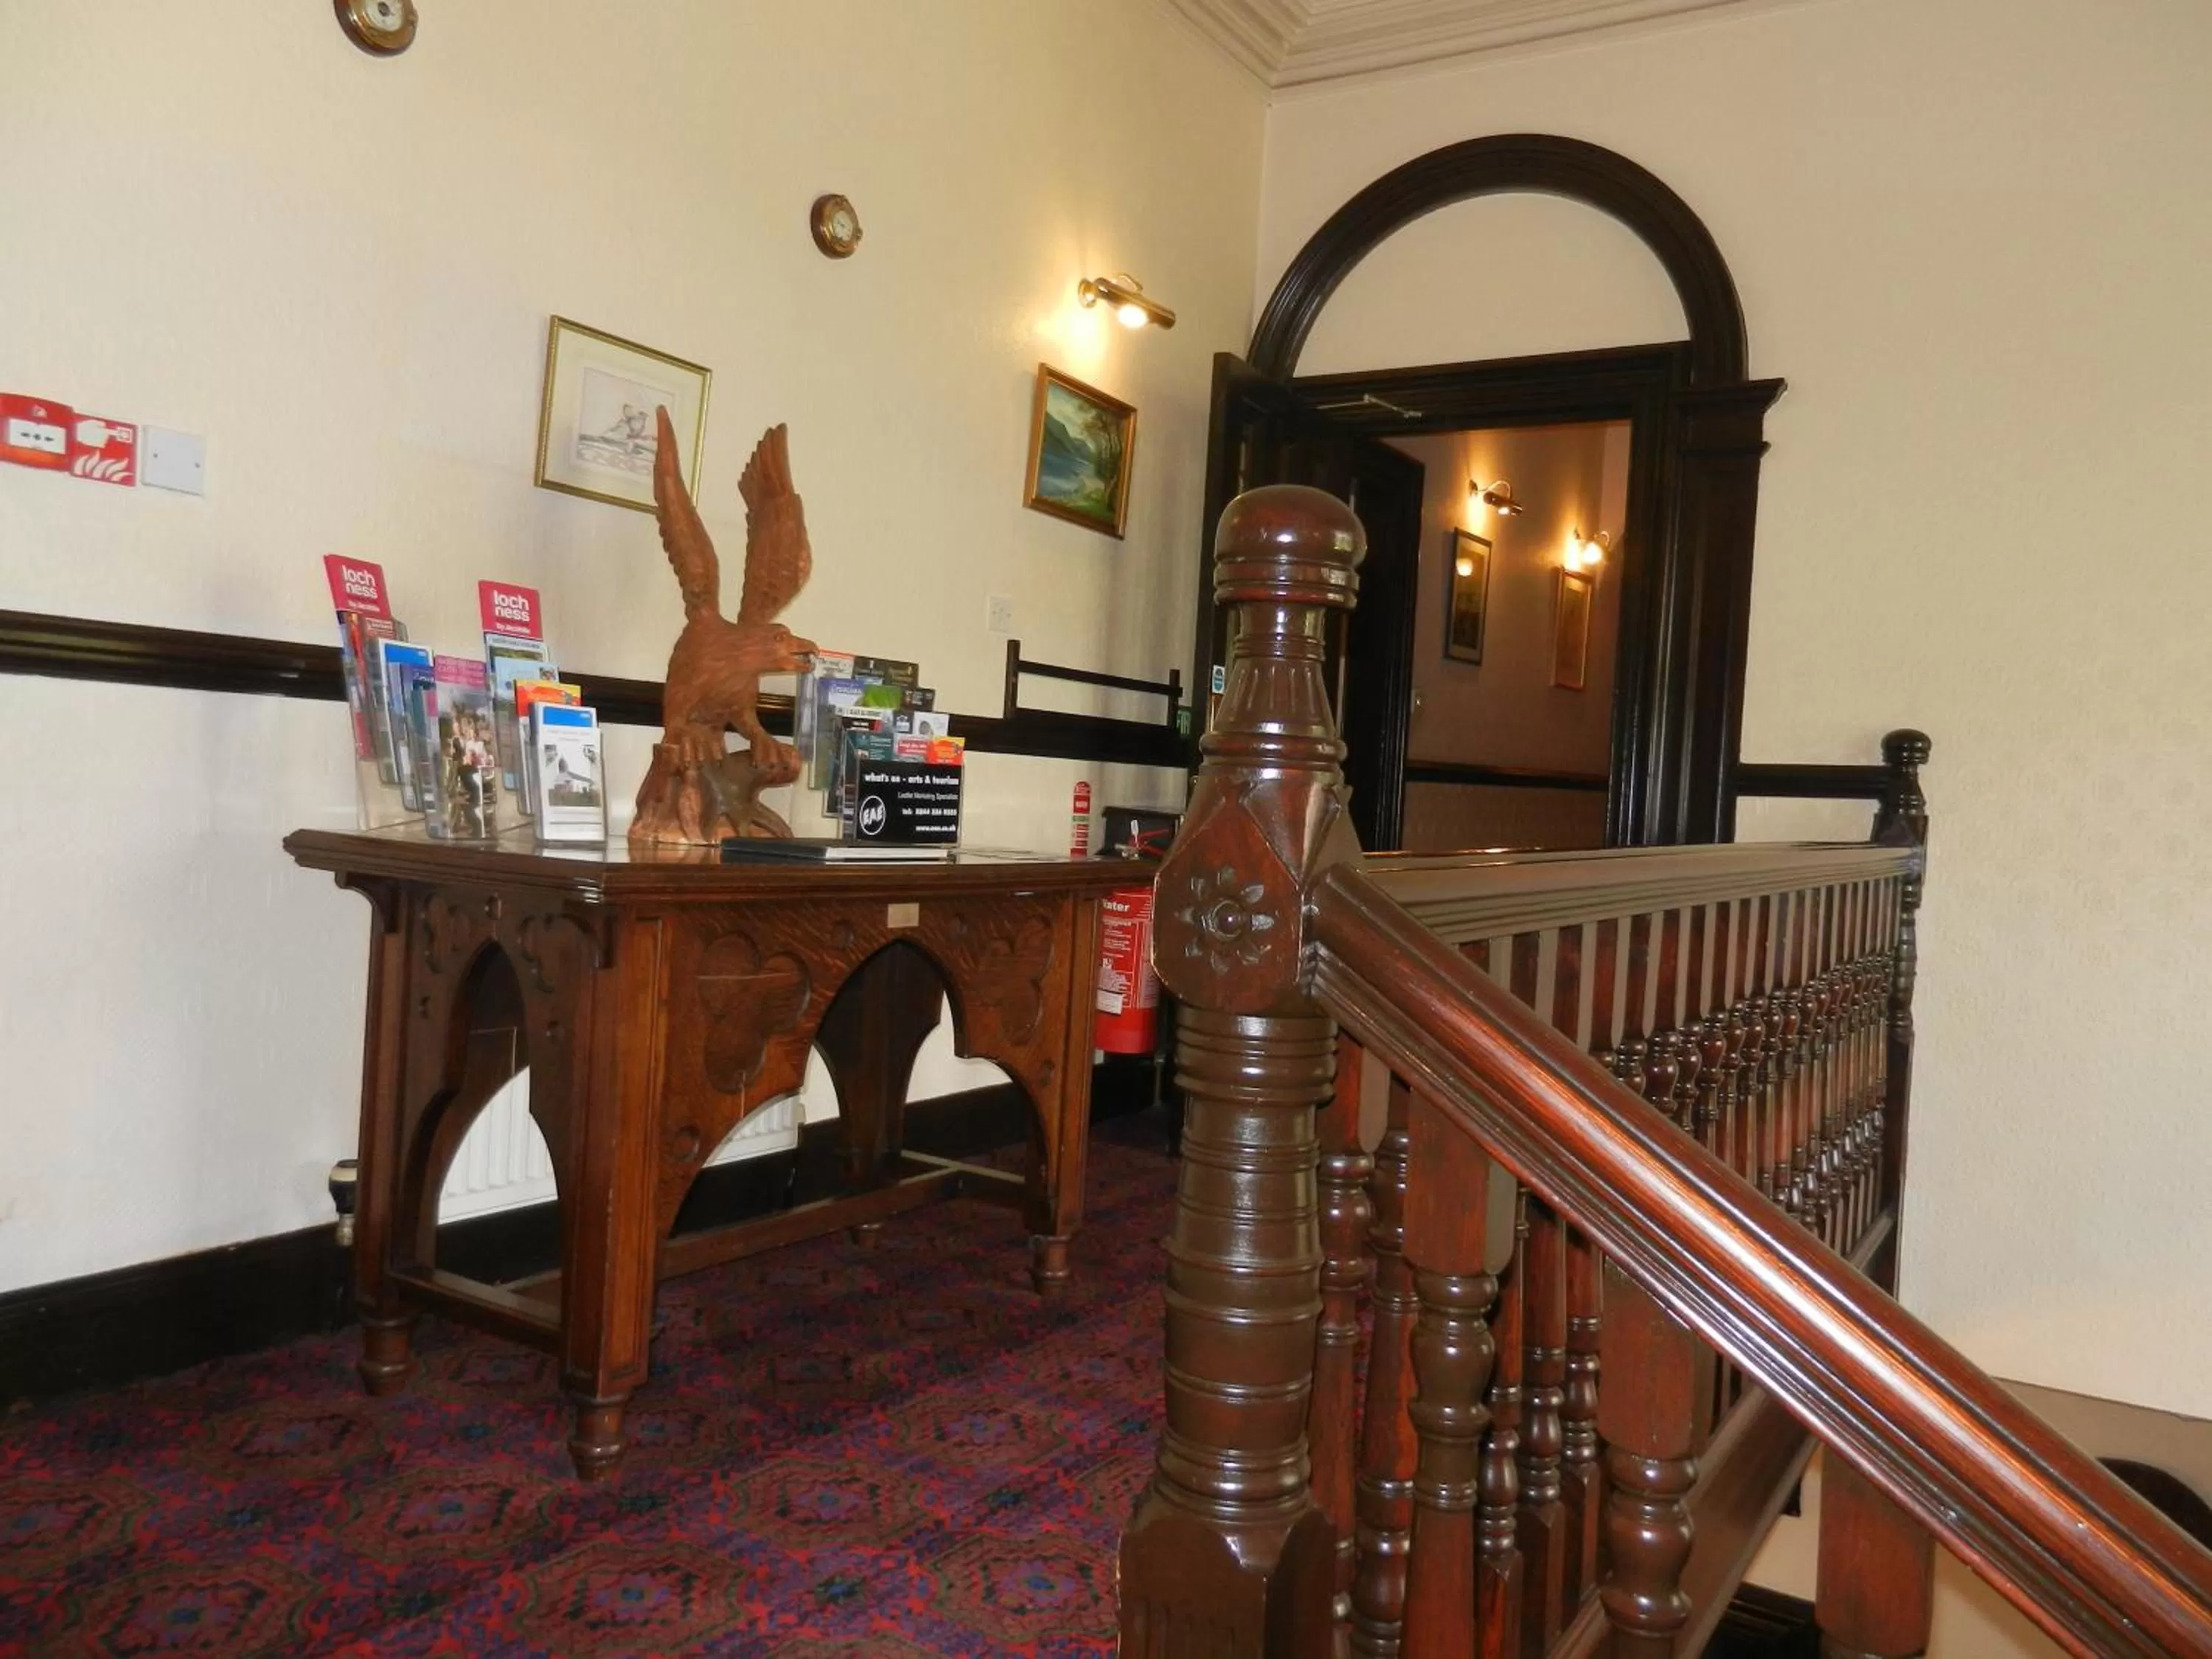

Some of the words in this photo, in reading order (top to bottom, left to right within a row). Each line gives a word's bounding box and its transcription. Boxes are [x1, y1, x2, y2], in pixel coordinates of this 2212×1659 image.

[341, 564, 376, 588] loch
[346, 582, 378, 599] ness
[493, 589, 530, 611] loch
[495, 605, 530, 622] ness
[864, 772, 889, 782] what's
[908, 775, 923, 784] arts
[924, 775, 931, 784] &
